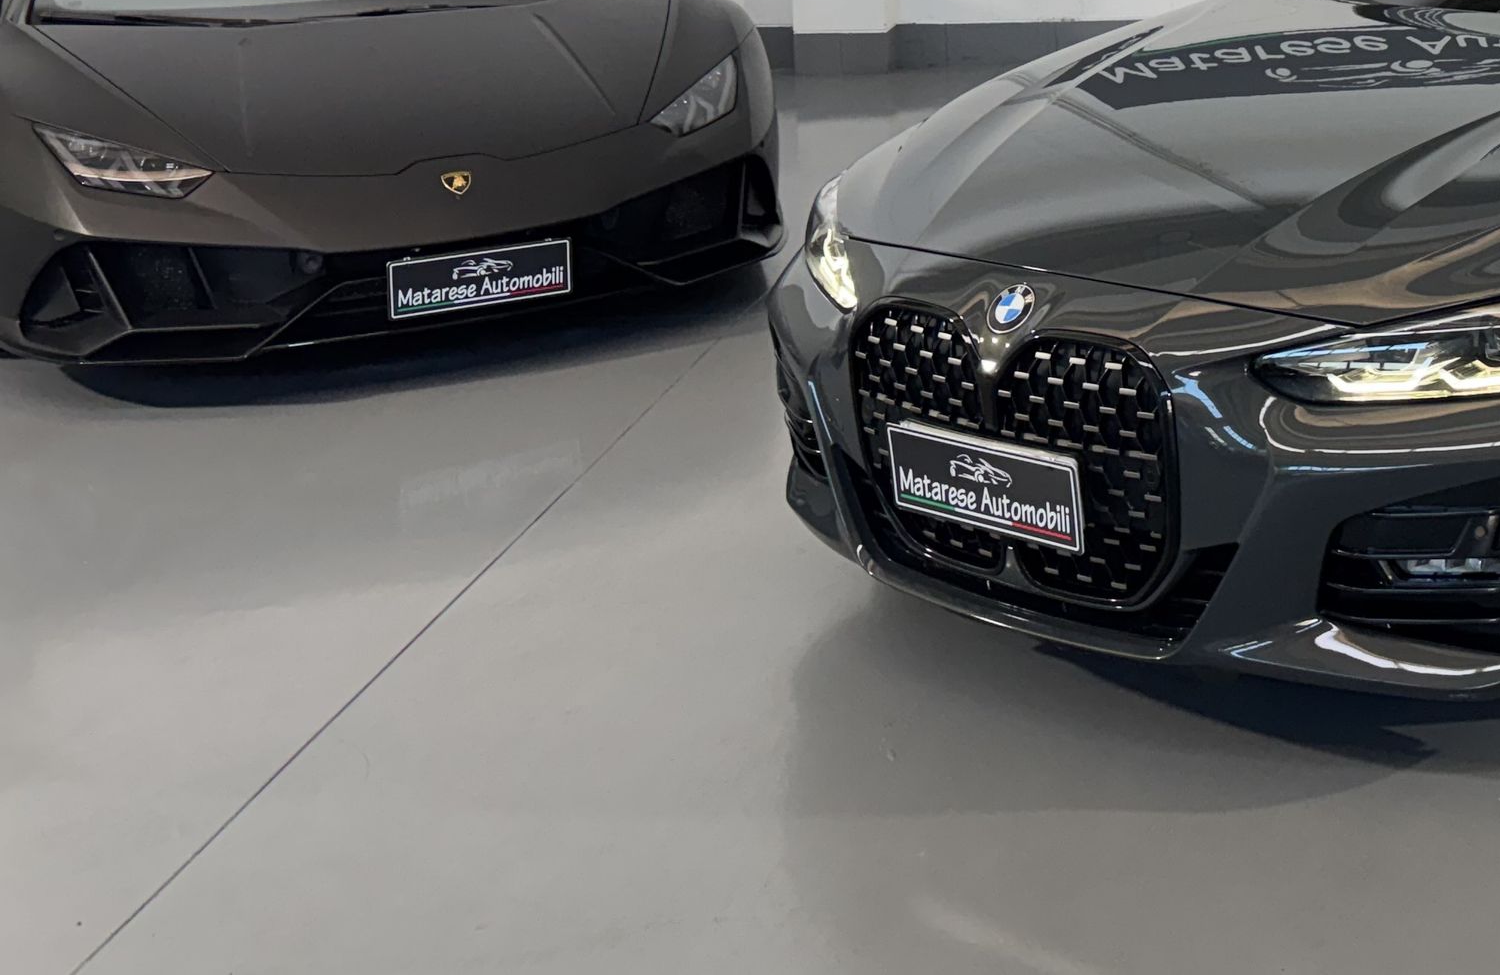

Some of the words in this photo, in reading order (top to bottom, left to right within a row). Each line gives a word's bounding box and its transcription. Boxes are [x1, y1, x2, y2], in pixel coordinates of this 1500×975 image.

[398, 283, 477, 308] Matarese
[480, 267, 564, 295] Automobili
[900, 466, 977, 510] Matarese
[981, 487, 1070, 534] Automobili
